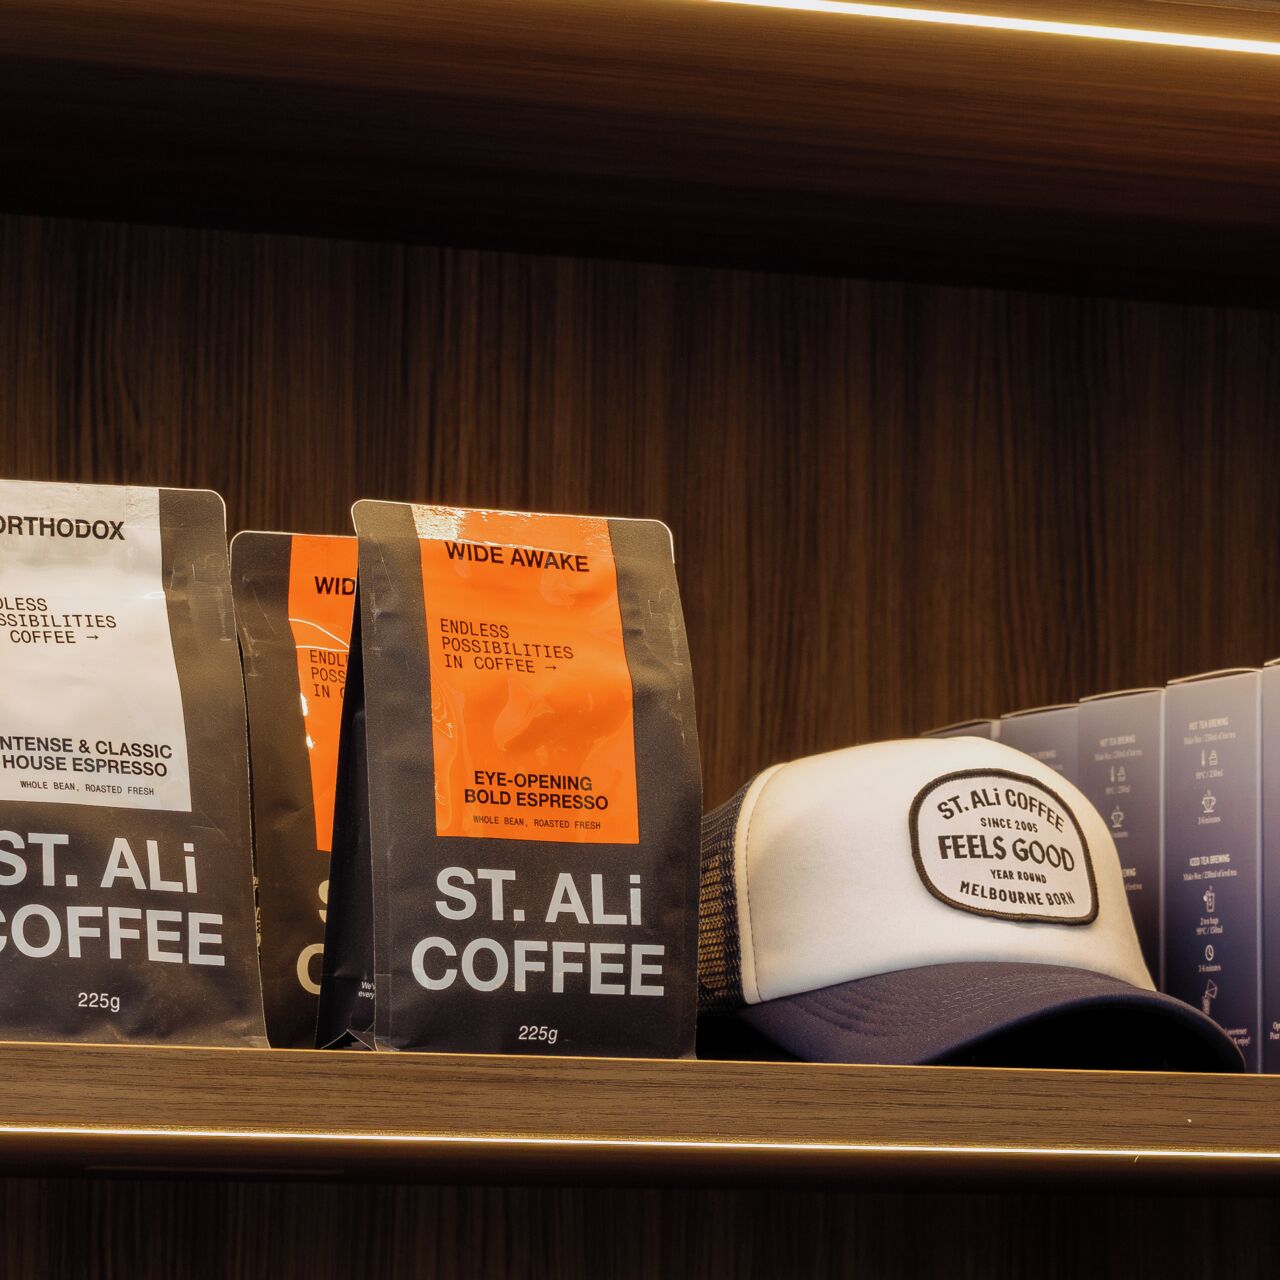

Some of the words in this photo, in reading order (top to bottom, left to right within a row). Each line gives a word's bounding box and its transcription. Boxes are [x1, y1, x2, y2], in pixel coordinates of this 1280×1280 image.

[444, 542, 505, 564] WIDE
[510, 548, 590, 573] AWAKE
[314, 576, 356, 596] WID
[9, 629, 77, 644] COFFEE
[440, 618, 510, 639] ENDLESS
[309, 649, 347, 665] ENDL
[441, 636, 574, 660] POSSIBILITIES
[444, 653, 463, 669] IN
[474, 656, 536, 674] COFFEE
[313, 683, 330, 699] IN
[78, 739, 91, 754] &
[95, 740, 173, 759] CLASSIC
[2, 754, 67, 771] HOUSE
[72, 757, 168, 777] ESPRESSO
[20, 780, 48, 790] WHOLE
[53, 781, 80, 792] BEAN,
[85, 784, 123, 795] ROASTED
[127, 786, 155, 796] FRESH
[474, 770, 593, 791] EYE-OPENING
[464, 788, 511, 806] BOLD
[516, 792, 609, 810] ESPRESSO
[937, 795, 969, 820] ST.
[970, 788, 1001, 810] ALi
[1005, 788, 1065, 833] COFFEE
[472, 815, 500, 825] WHOLE
[504, 817, 528, 828] BEAN,
[534, 819, 570, 829] ROASTED
[574, 820, 601, 830] FRESH
[980, 817, 1012, 829] SINCE
[1015, 819, 1039, 833] 2005
[937, 834, 1007, 860] FEELS
[1012, 837, 1075, 872] GOOD
[100, 837, 198, 894] ALi
[990, 869, 1015, 881] YEAR
[1017, 871, 1047, 884] ROUND
[435, 866, 526, 922] ST.
[545, 872, 642, 926] ALi
[960, 880, 1043, 906] MELBOURNE
[1046, 891, 1076, 906] BORN
[411, 936, 665, 997] COFFEE
[77, 992, 120, 1013] 225g
[518, 1025, 558, 1045] 225g
